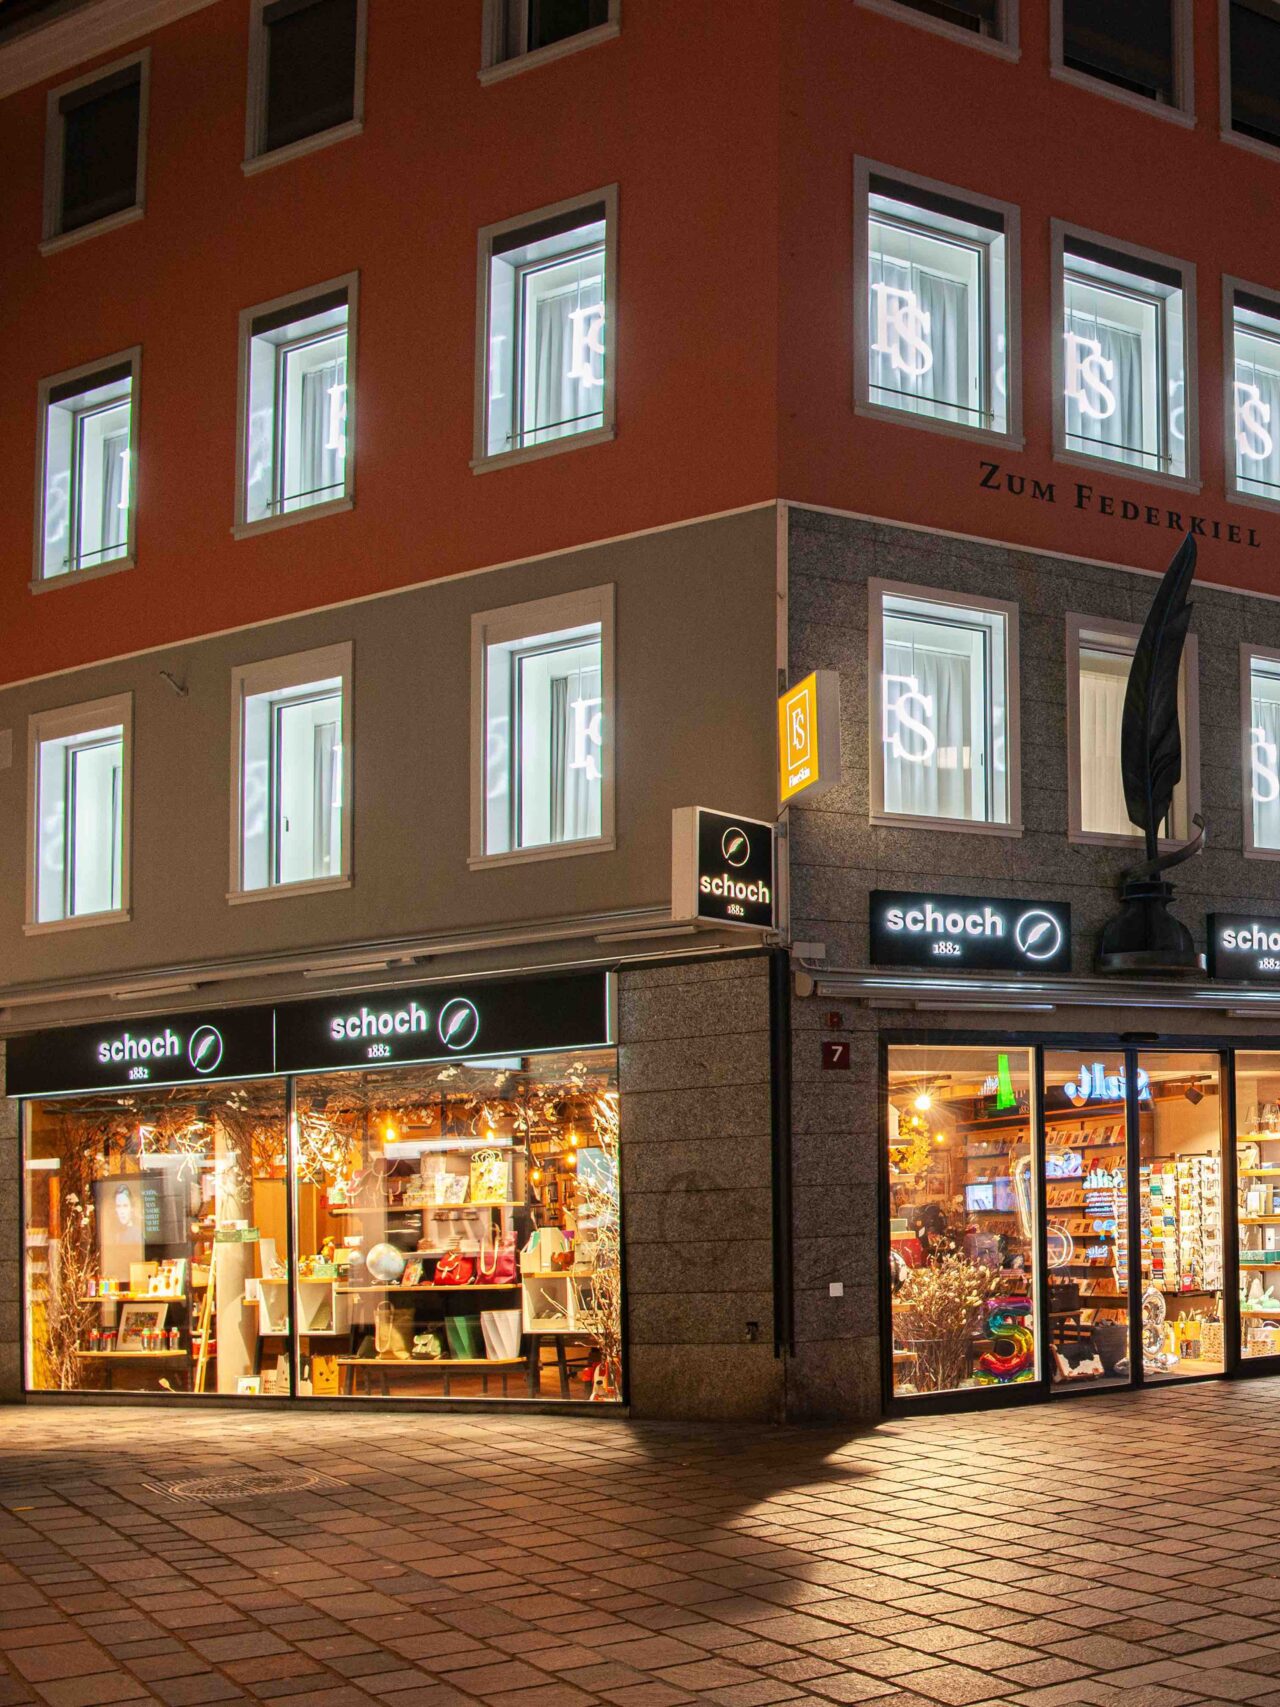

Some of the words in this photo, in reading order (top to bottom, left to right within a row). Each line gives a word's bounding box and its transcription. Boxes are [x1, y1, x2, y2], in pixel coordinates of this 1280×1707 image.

[871, 282, 933, 377] FS
[700, 873, 770, 904] schoch
[727, 904, 744, 916] 1882
[887, 904, 1004, 936] schoch
[933, 943, 961, 956] 1882
[1258, 959, 1280, 971] 1882
[331, 1003, 427, 1041] schoch
[98, 1029, 179, 1062] schoch
[367, 1043, 391, 1058] 1882
[831, 1045, 843, 1062] 7
[129, 1066, 149, 1079] 1882
